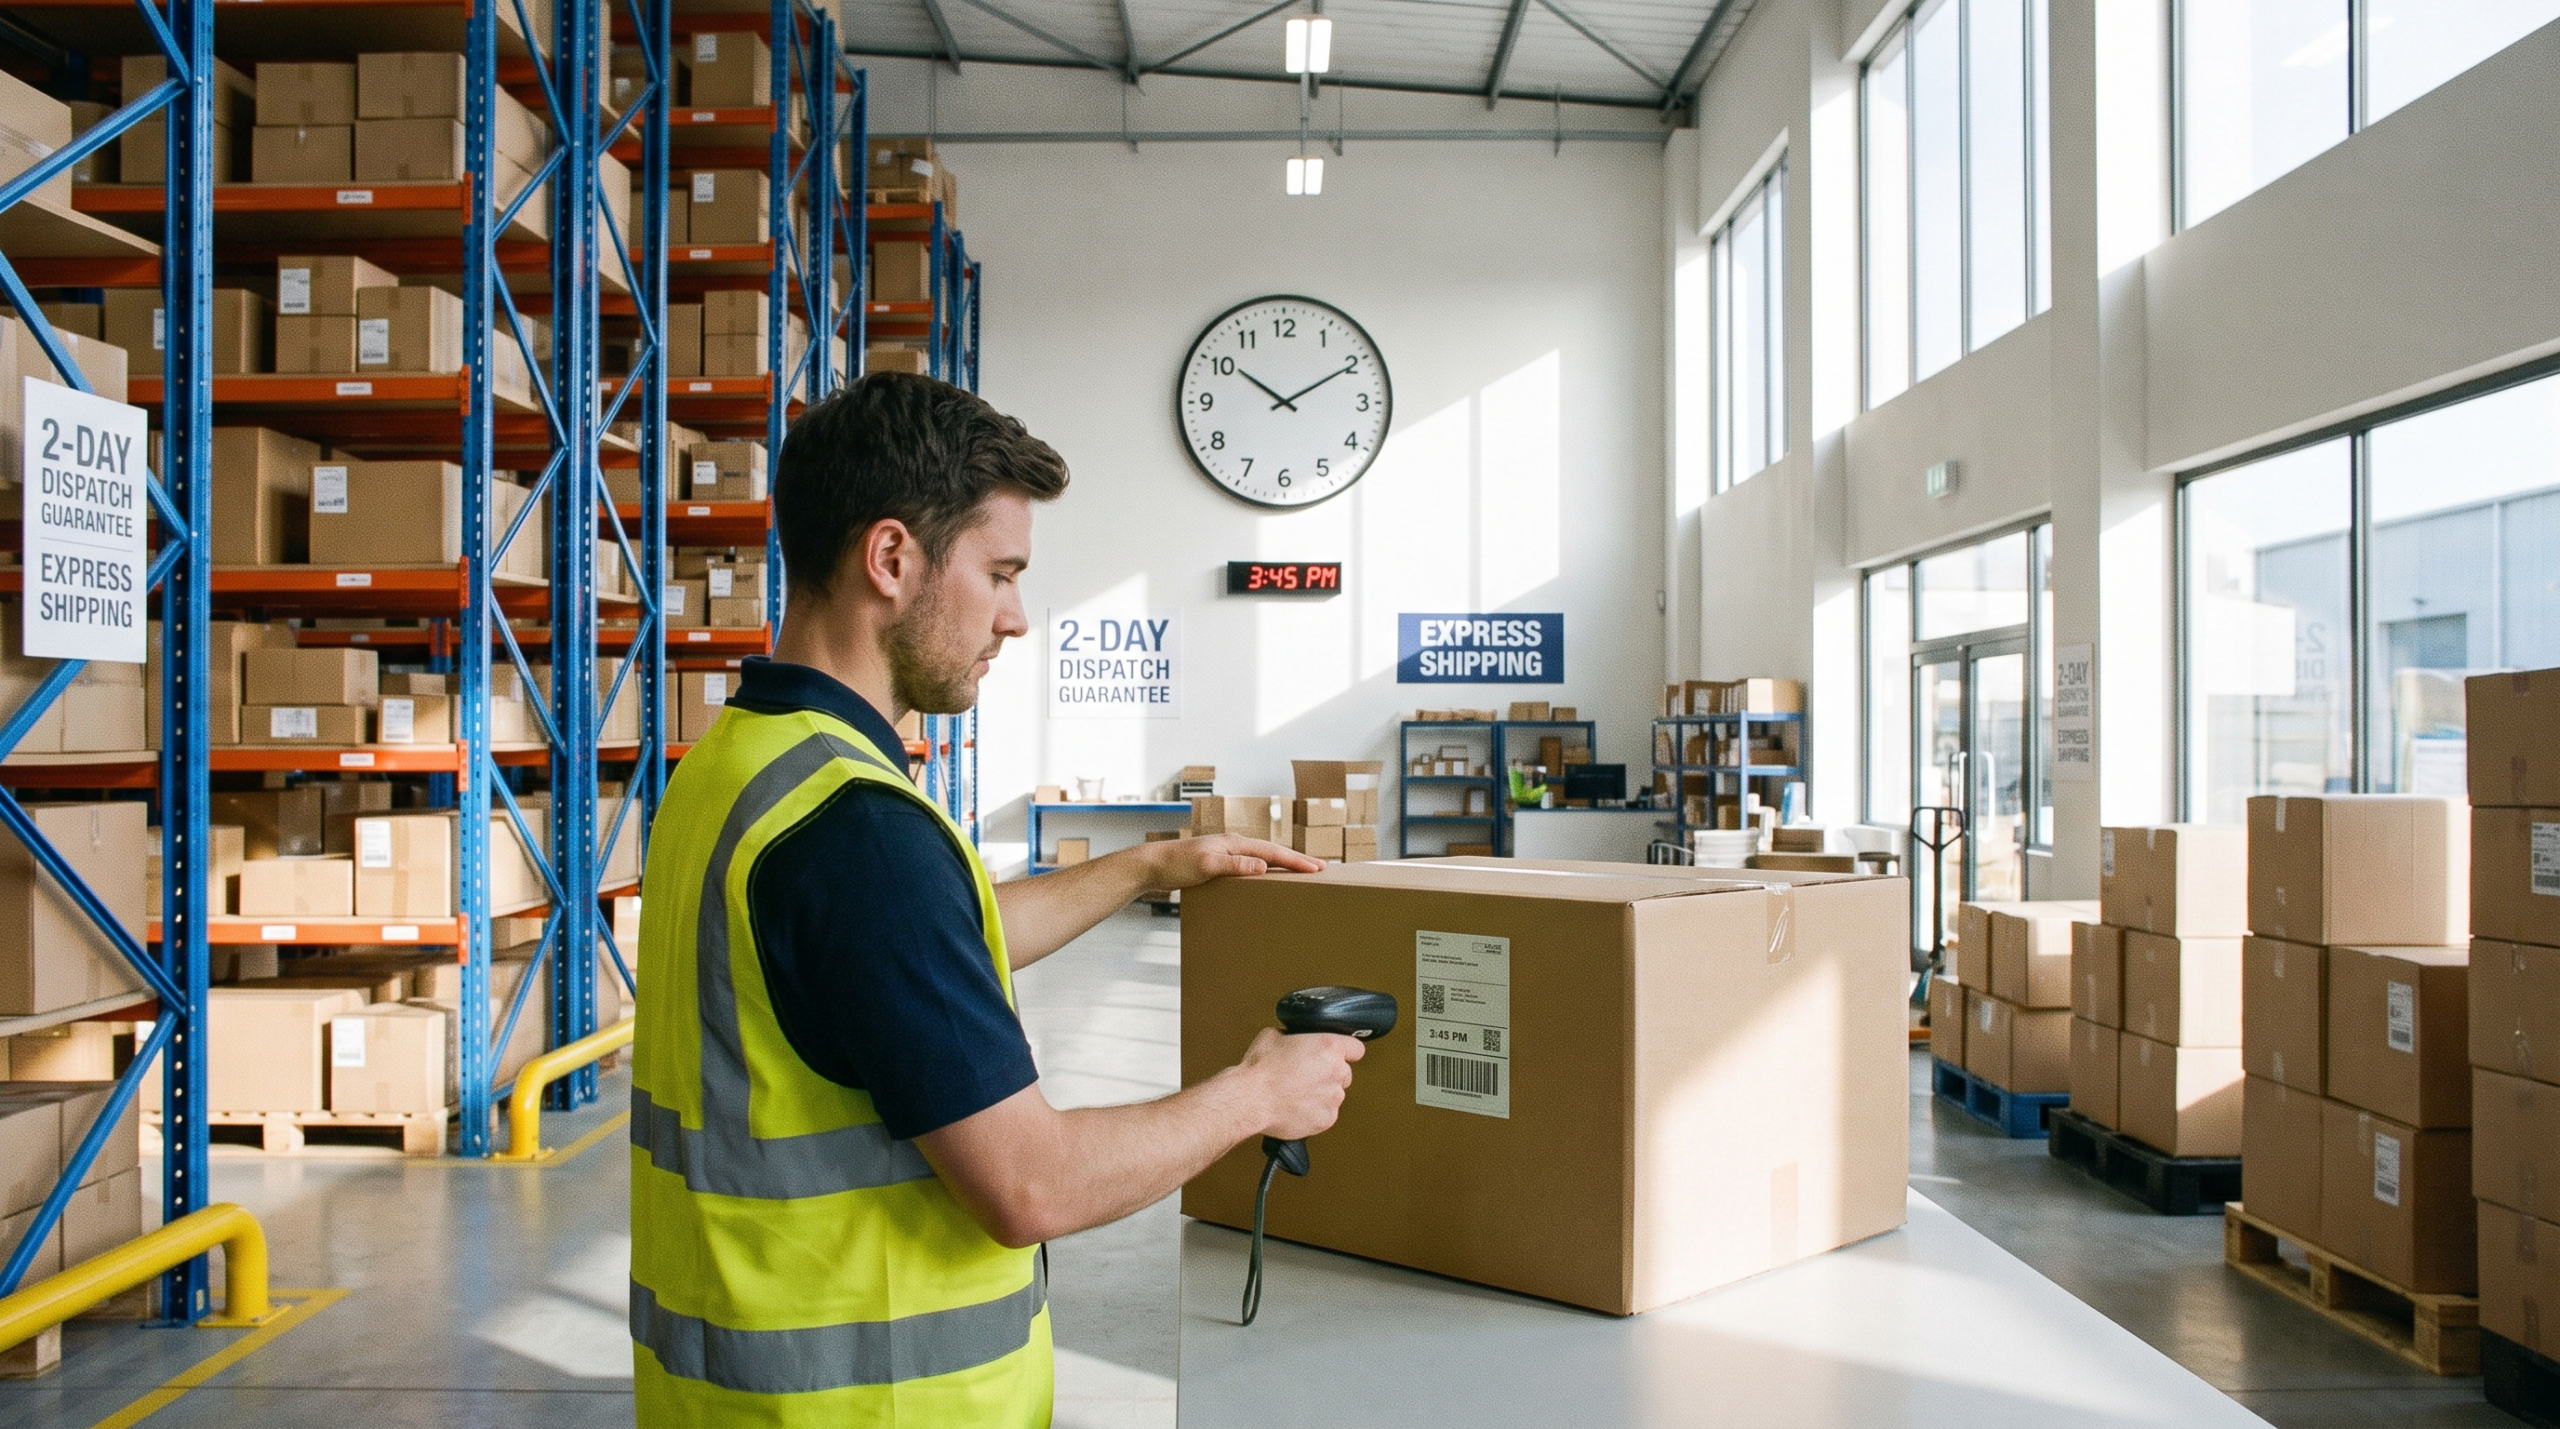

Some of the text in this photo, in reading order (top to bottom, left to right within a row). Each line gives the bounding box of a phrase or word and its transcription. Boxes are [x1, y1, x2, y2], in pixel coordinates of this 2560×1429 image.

[1273, 318, 1296, 338] 12
[1238, 329, 1255, 349] 11
[1319, 329, 1326, 348] 1
[1211, 356, 1235, 376] 10
[1345, 355, 1358, 374] 2
[1199, 392, 1214, 411] 9
[1355, 393, 1369, 412] 3
[42, 417, 131, 476] 2-DAY
[1210, 430, 1225, 450] 8
[1344, 431, 1358, 450] 4
[1240, 458, 1254, 478] 7
[1316, 458, 1329, 477] 5
[1277, 468, 1292, 488] 6
[42, 467, 132, 510] DISPATCH
[41, 502, 133, 538] GUARANTEE
[41, 552, 132, 593] EXPRESS
[1248, 565, 1337, 589] 3:45 PM
[40, 591, 133, 629] SHIPPING
[1060, 619, 1170, 652] 2-DAY
[1420, 619, 1543, 647] EXPRESS
[1060, 658, 1170, 680] DISPATCH
[1419, 650, 1543, 676] SHIPPING
[2058, 661, 2089, 685] 2-DAY
[1059, 685, 1171, 704] GUARANTEE
[1429, 1029, 1467, 1042] 3:45 PM
